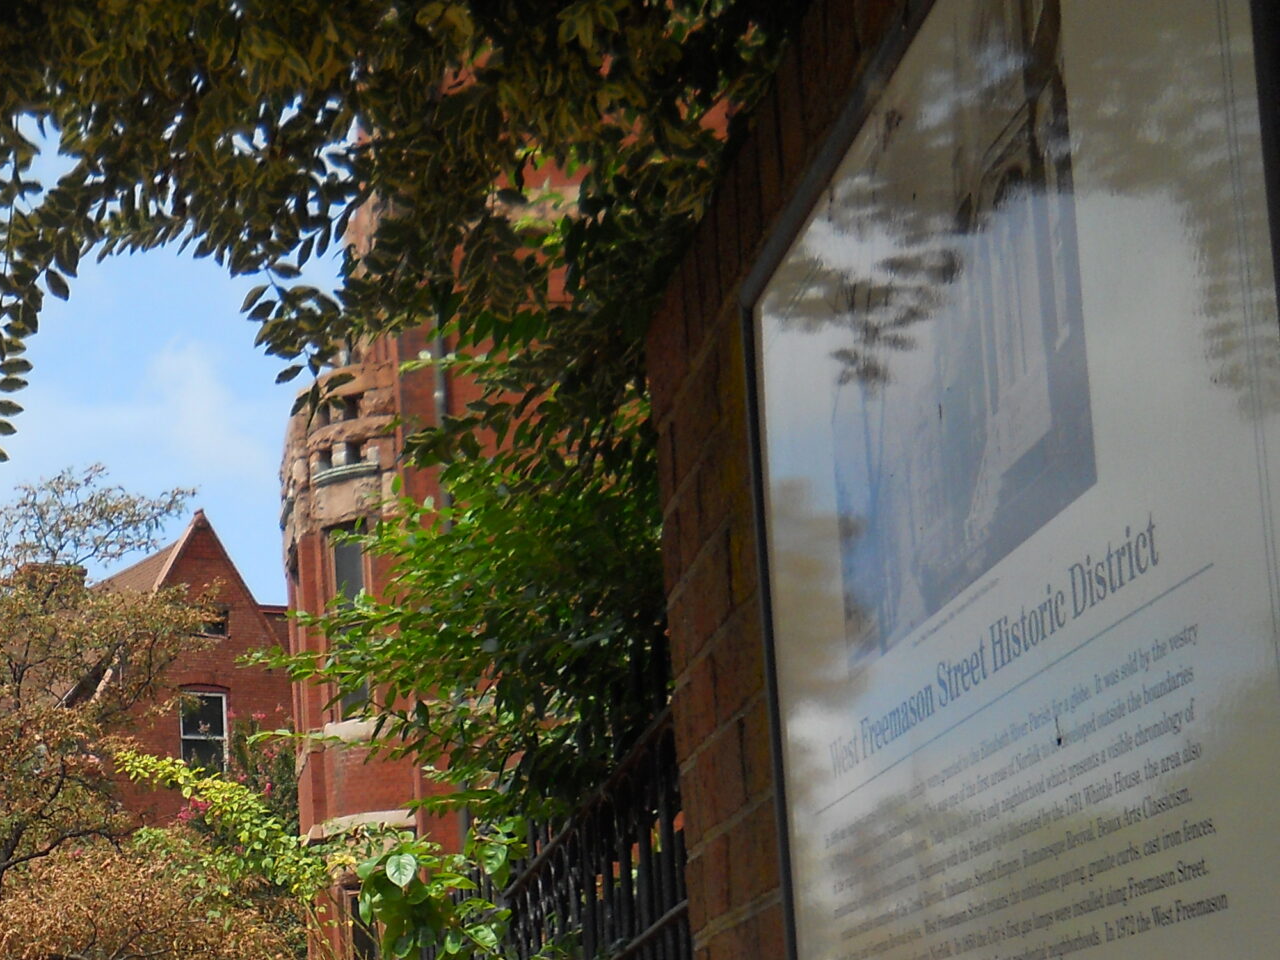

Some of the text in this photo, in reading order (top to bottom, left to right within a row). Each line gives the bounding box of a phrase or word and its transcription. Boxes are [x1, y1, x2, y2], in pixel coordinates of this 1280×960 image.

[829, 734, 859, 778] West
[860, 684, 935, 759] Freemason
[936, 638, 987, 707] Street
[990, 584, 1066, 673] Historic
[1069, 512, 1159, 619] District
[969, 746, 980, 765] the
[1028, 702, 1051, 732] Parish
[1051, 698, 1063, 718] for
[1063, 696, 1069, 712] a
[1069, 681, 1091, 713] glebe.
[1094, 673, 1101, 694] It
[1103, 667, 1119, 689] was
[1120, 651, 1137, 679] sold
[1138, 646, 1150, 671] by
[1151, 637, 1167, 661] the
[1168, 621, 1198, 652] vestry
[959, 782, 965, 801] of
[965, 778, 976, 798] the
[976, 771, 990, 792] first
[990, 764, 1007, 784] areas
[1007, 755, 1015, 775] of
[1015, 741, 1041, 771] Norfolk
[1096, 697, 1126, 728] outside
[1127, 689, 1142, 712] the
[1142, 664, 1194, 704] boundaries
[985, 797, 1000, 819] only
[1001, 772, 1045, 812] neighborhood
[1045, 762, 1066, 789] which
[1067, 750, 1099, 784] presents
[1100, 747, 1106, 763] a
[1107, 730, 1132, 759] visible
[1134, 709, 1182, 746] chronology
[1184, 696, 1196, 722] of
[959, 844, 969, 862] the
[968, 831, 992, 858] Federal
[1041, 806, 1051, 829] by
[1051, 800, 1064, 821] the
[1064, 789, 1082, 815] 1791
[1082, 778, 1113, 807] Whittle
[1143, 757, 1158, 780] the
[1159, 750, 1181, 773] area
[1182, 739, 1203, 763] also
[1008, 884, 1020, 904] the
[1087, 850, 1115, 881] granite
[1143, 832, 1160, 855] cast
[1161, 827, 1181, 849] iron
[1182, 815, 1216, 841] fences,
[1096, 814, 1121, 837] Beaux
[1122, 805, 1141, 826] Arts
[1006, 918, 1020, 937] first
[1020, 917, 1032, 937] gas
[1031, 909, 1054, 930] lamps
[1054, 903, 1072, 922] were
[1071, 887, 1104, 916] installed
[1105, 883, 1128, 906] along
[1127, 869, 1175, 898] Freemason
[1176, 854, 1210, 882] Street.
[1048, 924, 1102, 959] neighborhoods.
[1104, 920, 1114, 941] In
[1115, 912, 1135, 938] 1972
[1136, 909, 1151, 932] the
[1151, 903, 1174, 927] West
[1174, 891, 1228, 921] Freemason
